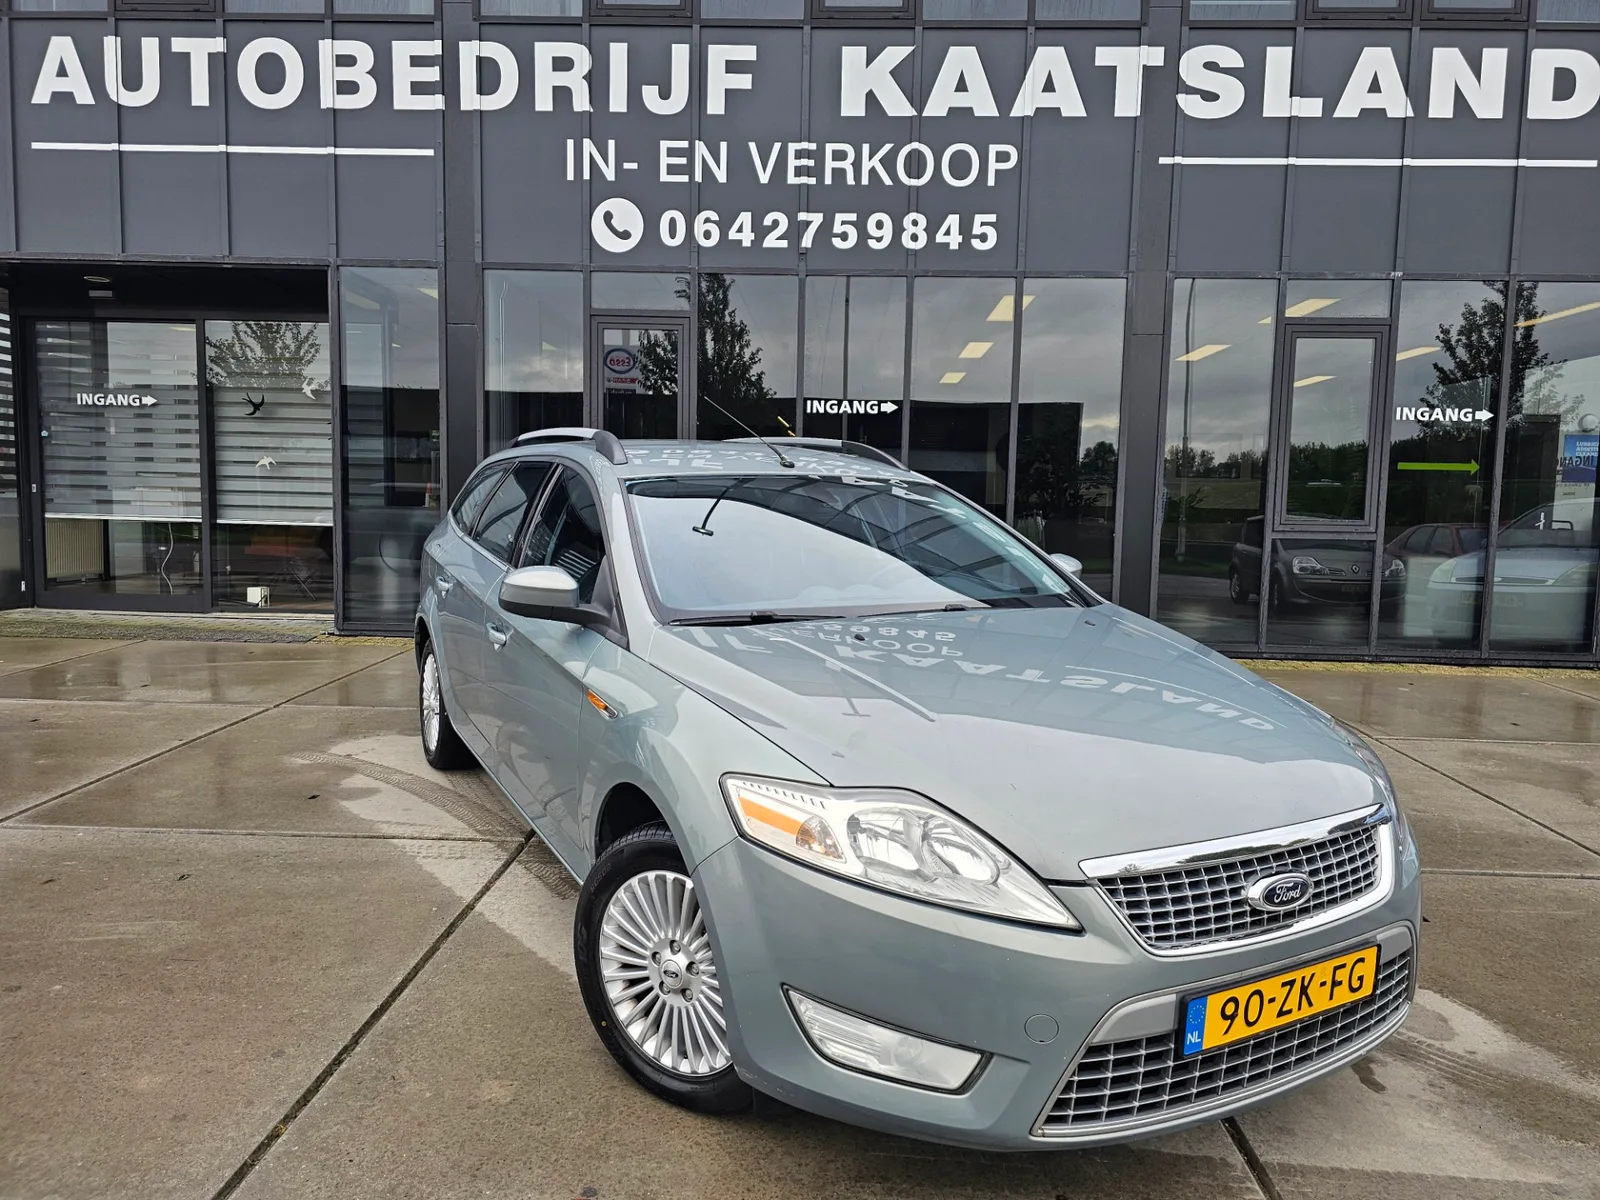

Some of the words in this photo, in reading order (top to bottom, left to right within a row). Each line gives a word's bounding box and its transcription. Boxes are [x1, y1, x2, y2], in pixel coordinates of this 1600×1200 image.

[31, 36, 757, 115] AUTOBEDRIJF
[840, 44, 1600, 119] KAATSLAND
[566, 138, 639, 182] IN-
[659, 139, 728, 184] EN
[747, 141, 1019, 188] VERKOOP
[659, 209, 998, 251] 0642759845
[76, 393, 140, 407] INGANG
[806, 400, 879, 414] INGANG
[1395, 406, 1473, 422] INGANG
[1273, 882, 1302, 904] Ford
[1219, 956, 1367, 1036] 90-ZK-FG
[1186, 1030, 1202, 1046] NL
